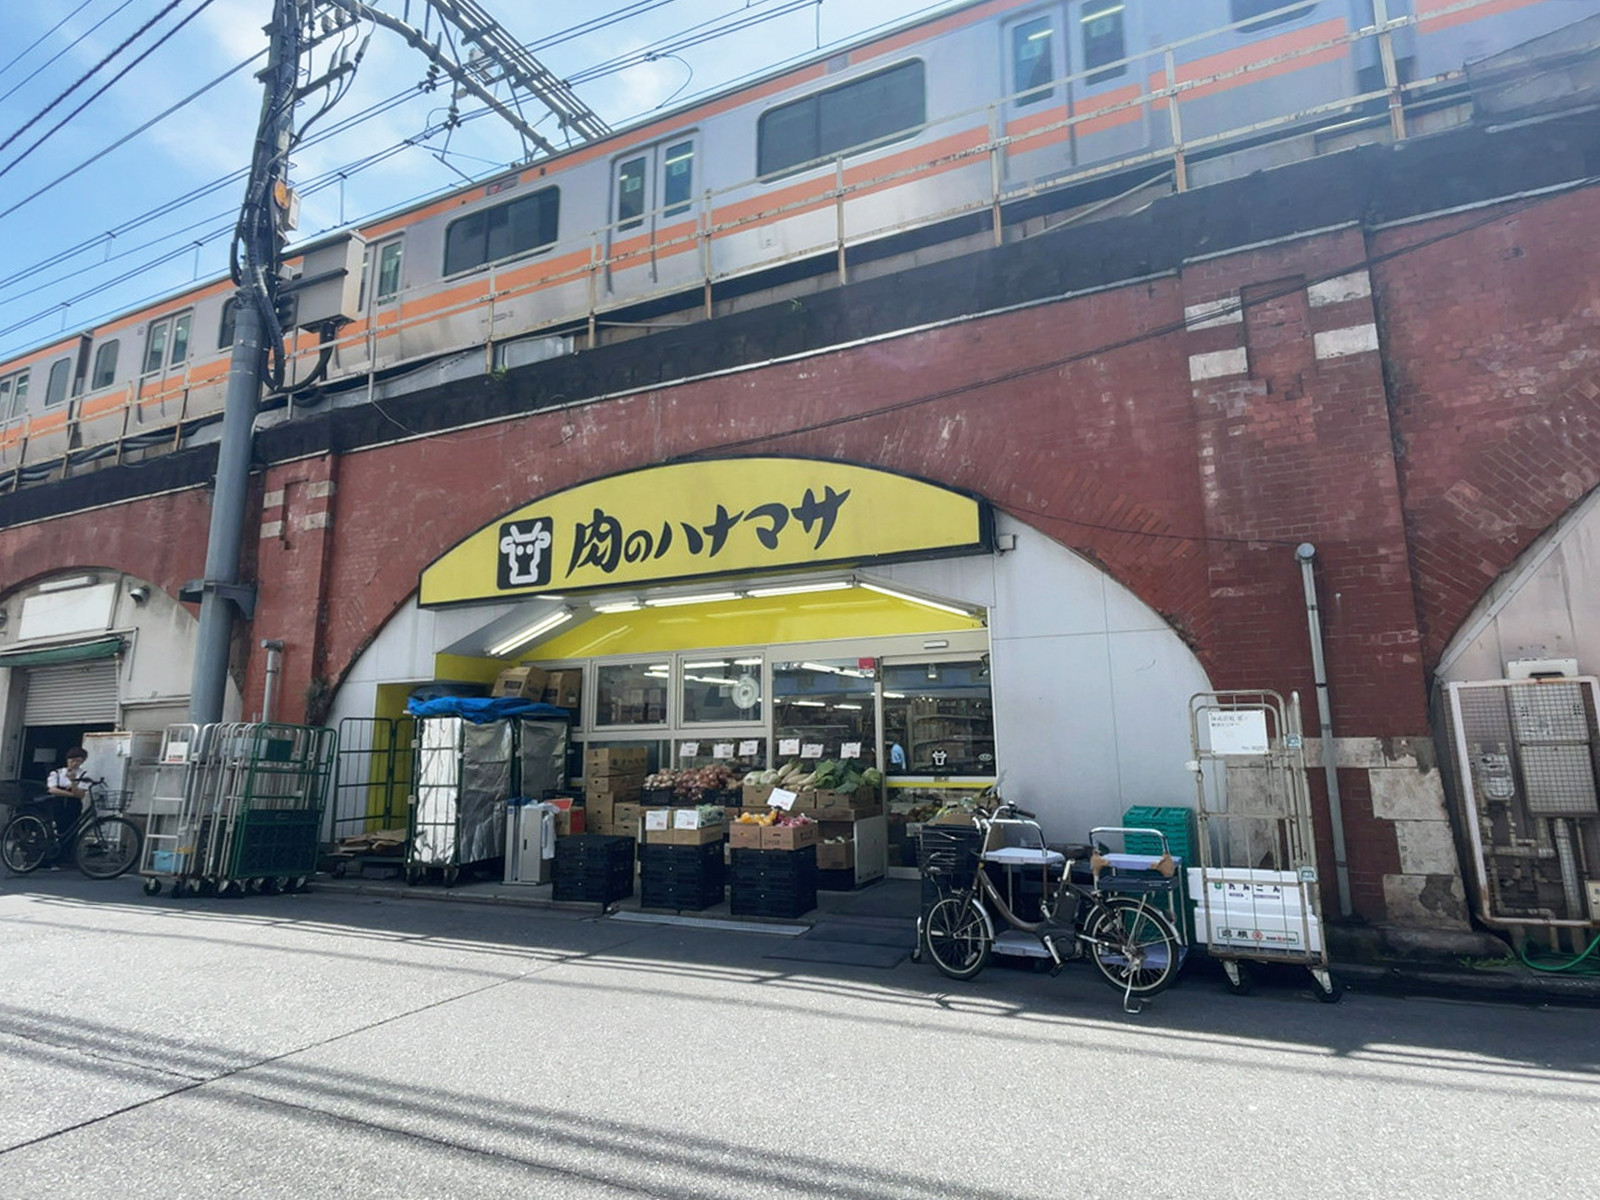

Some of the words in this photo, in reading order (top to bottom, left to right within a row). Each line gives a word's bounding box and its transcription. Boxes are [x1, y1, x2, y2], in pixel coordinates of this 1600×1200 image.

[565, 486, 851, 579] 肉のハナマサ
